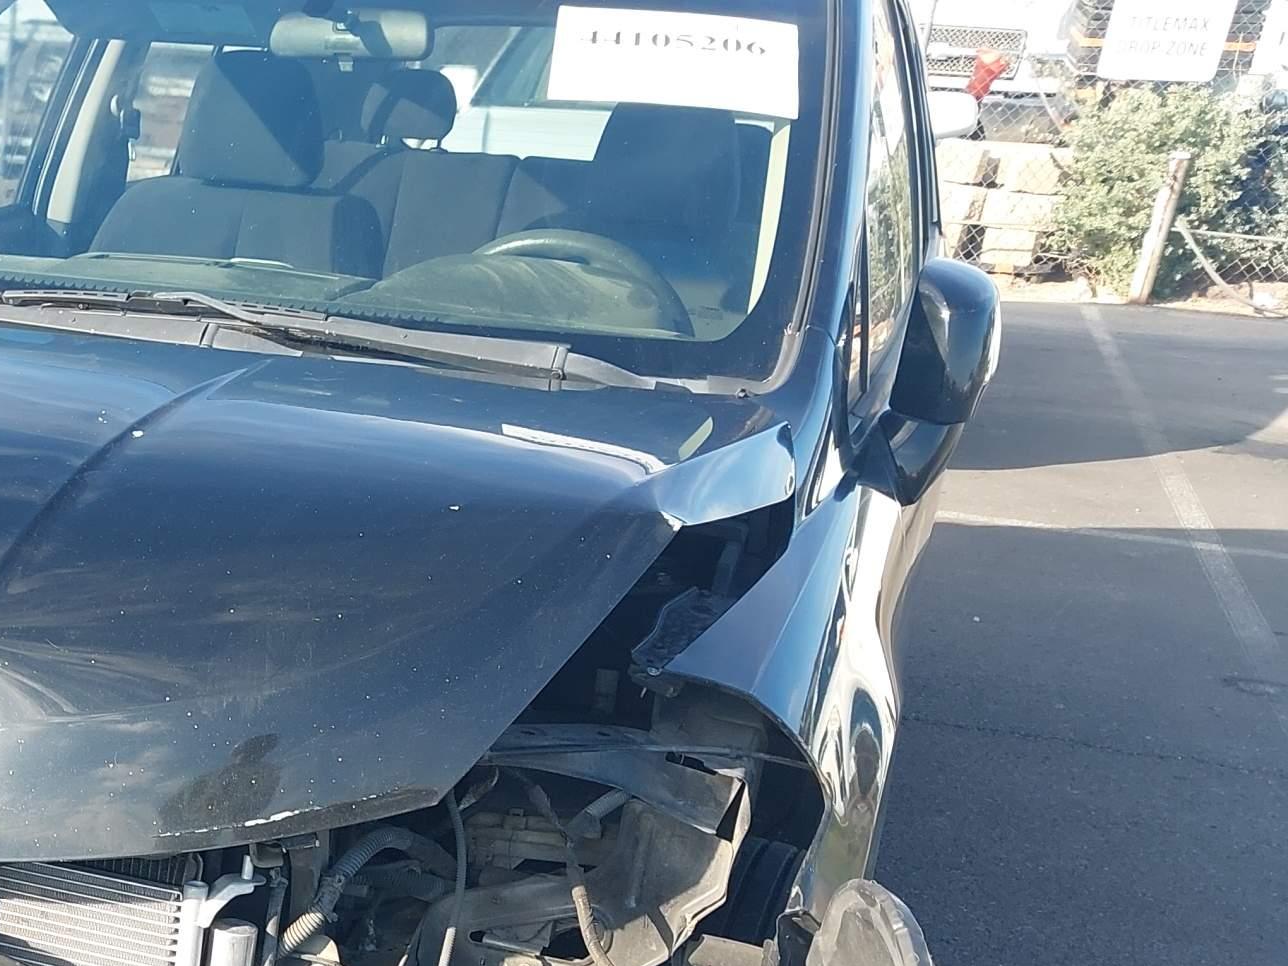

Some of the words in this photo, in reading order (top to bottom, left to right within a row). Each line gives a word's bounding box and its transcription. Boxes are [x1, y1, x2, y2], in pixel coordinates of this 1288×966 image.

[1129, 15, 1210, 33] TITLEMAX
[578, 29, 767, 56] 44105206
[1165, 39, 1210, 57] ZONE
